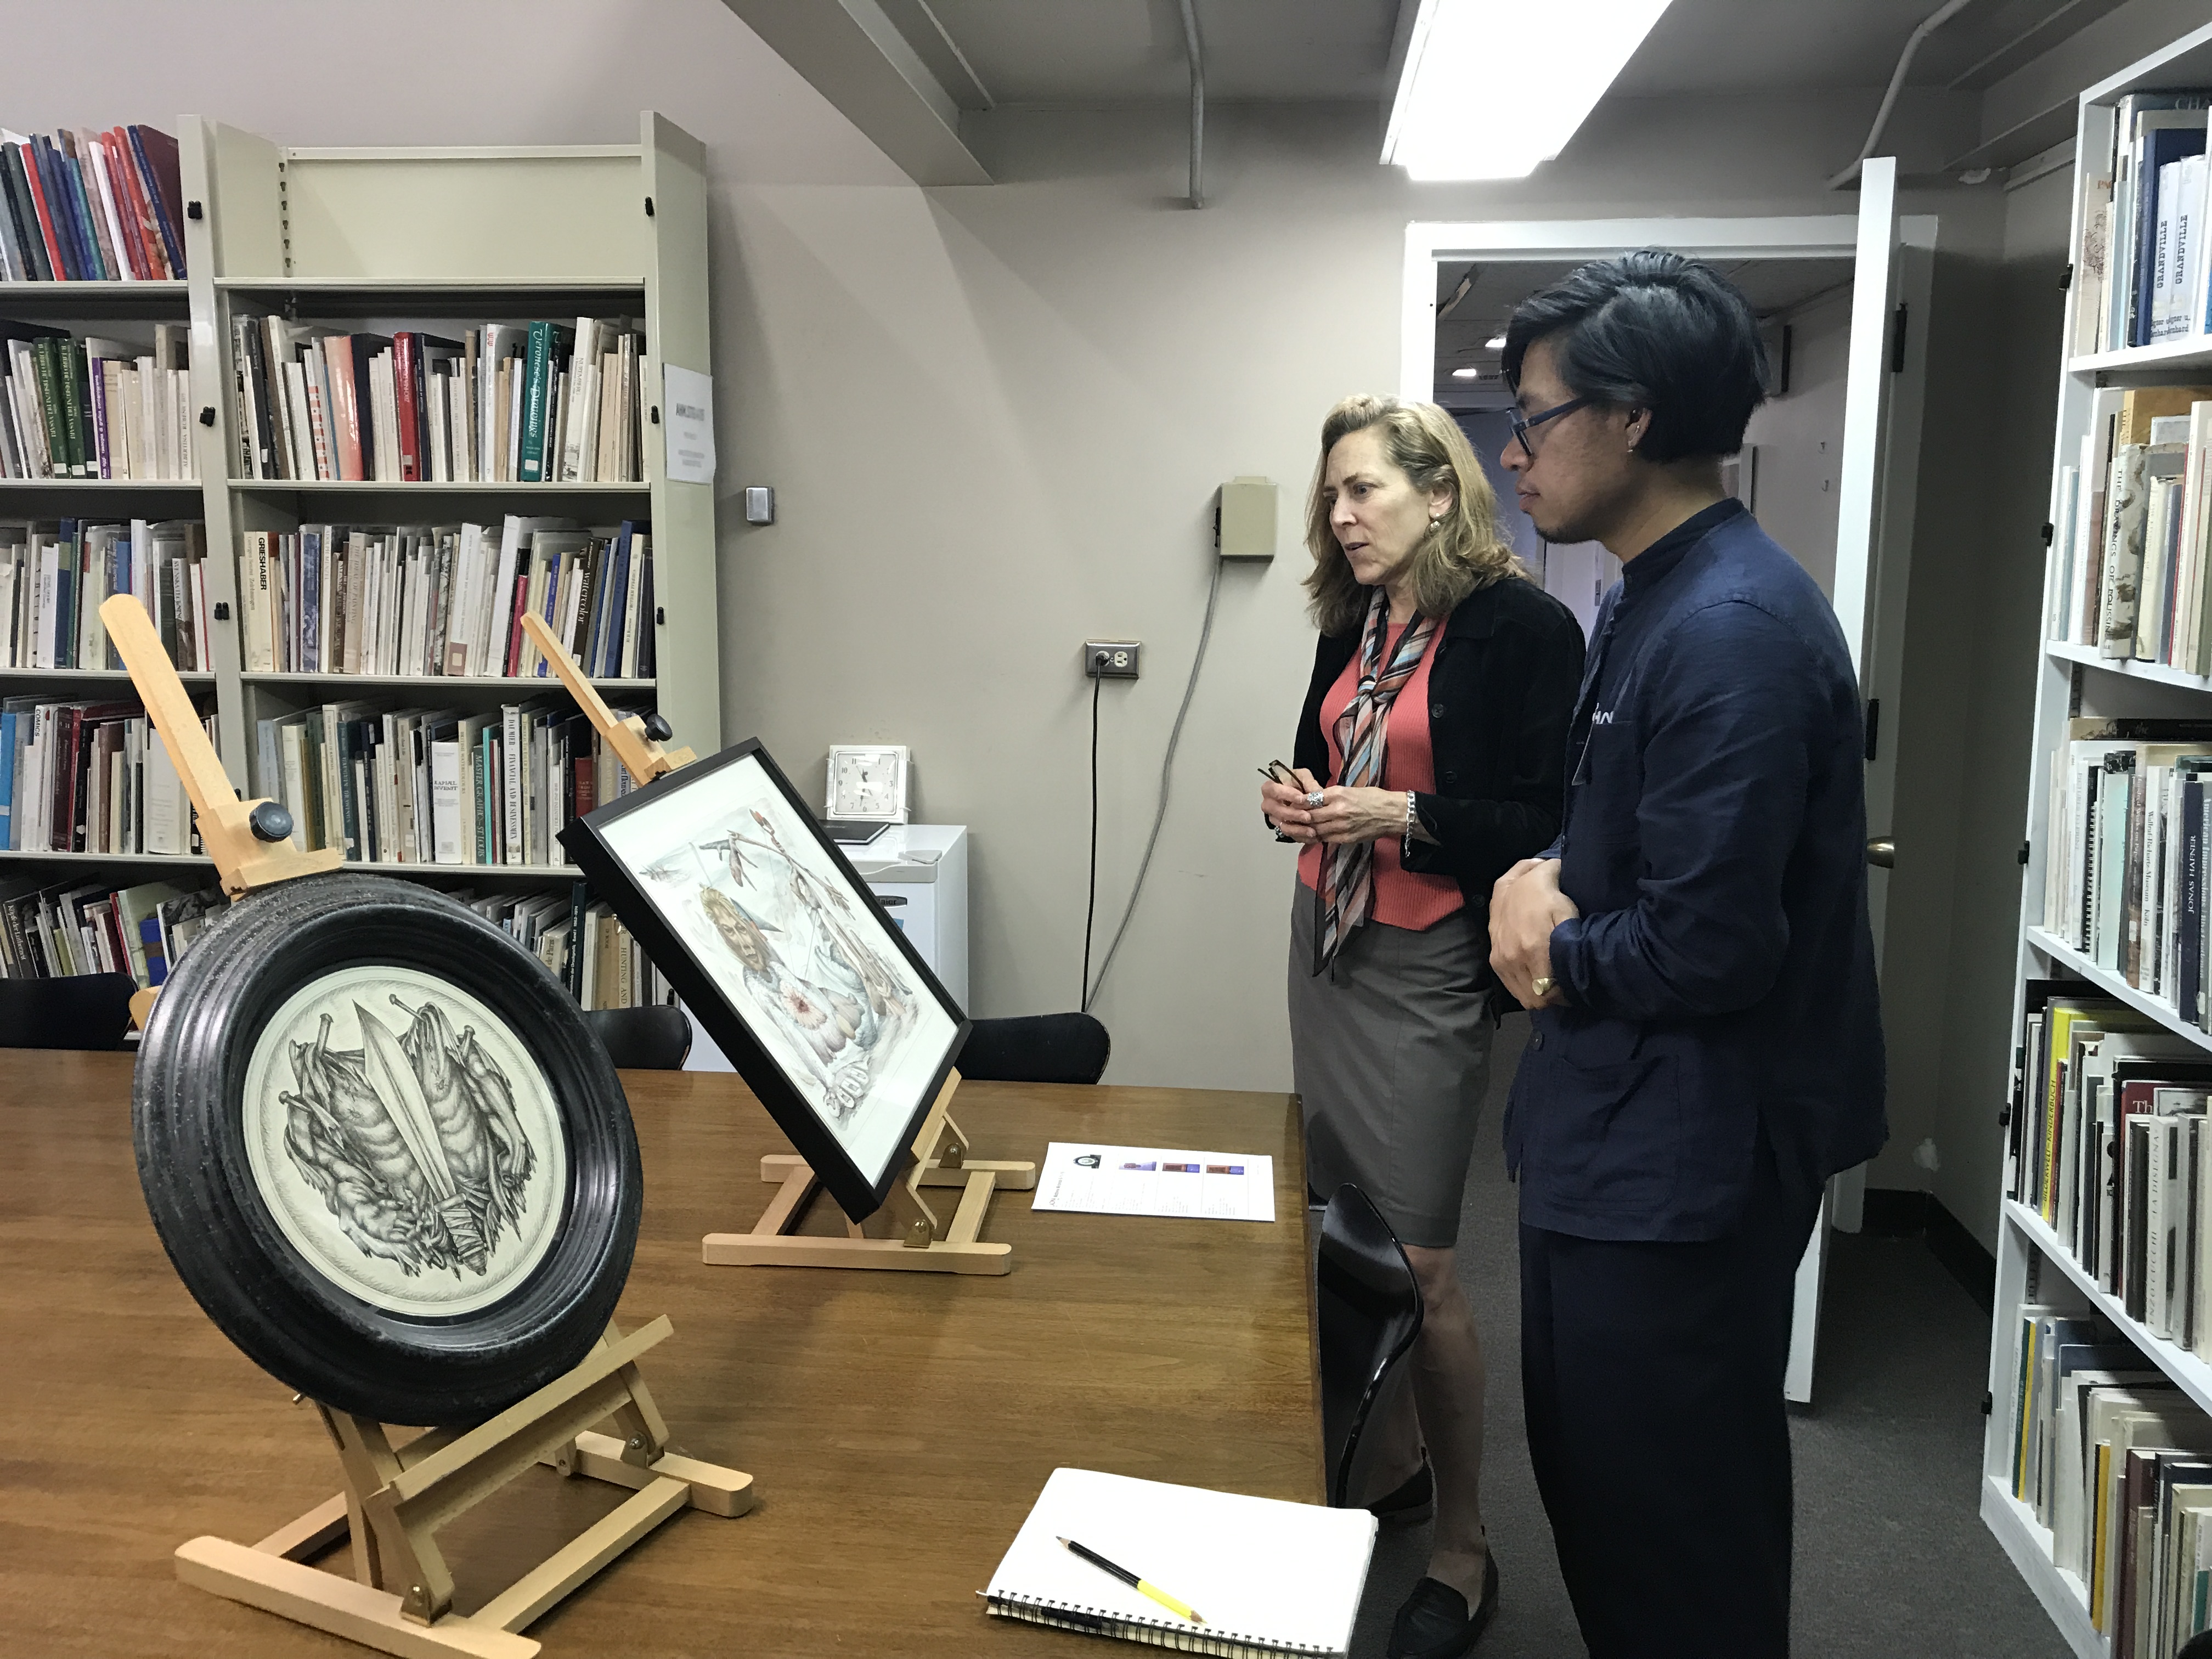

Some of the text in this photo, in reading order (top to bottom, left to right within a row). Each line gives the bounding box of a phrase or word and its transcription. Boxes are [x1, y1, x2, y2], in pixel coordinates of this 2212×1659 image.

[2157, 221, 2168, 289] GRANDVILLE
[2175, 215, 2187, 284] GRANDVILLE
[528, 329, 544, 438] Veronese's Drawings
[576, 358, 584, 395] NUREMBERG
[2111, 499, 2121, 557] DRAWINGS
[258, 537, 267, 590] GRIESHABER
[2109, 565, 2115, 581] OF
[578, 572, 591, 624] watercolor
[509, 801, 517, 839] BUSINESSMEN
[2203, 798, 2211, 844] American
[2145, 811, 2154, 902] Wallraf-Richartz-Museum
[2201, 847, 2210, 907] Impressions
[545, 939, 555, 965] de Paris
[2046, 1080, 2056, 1142] KINDERBUCH
